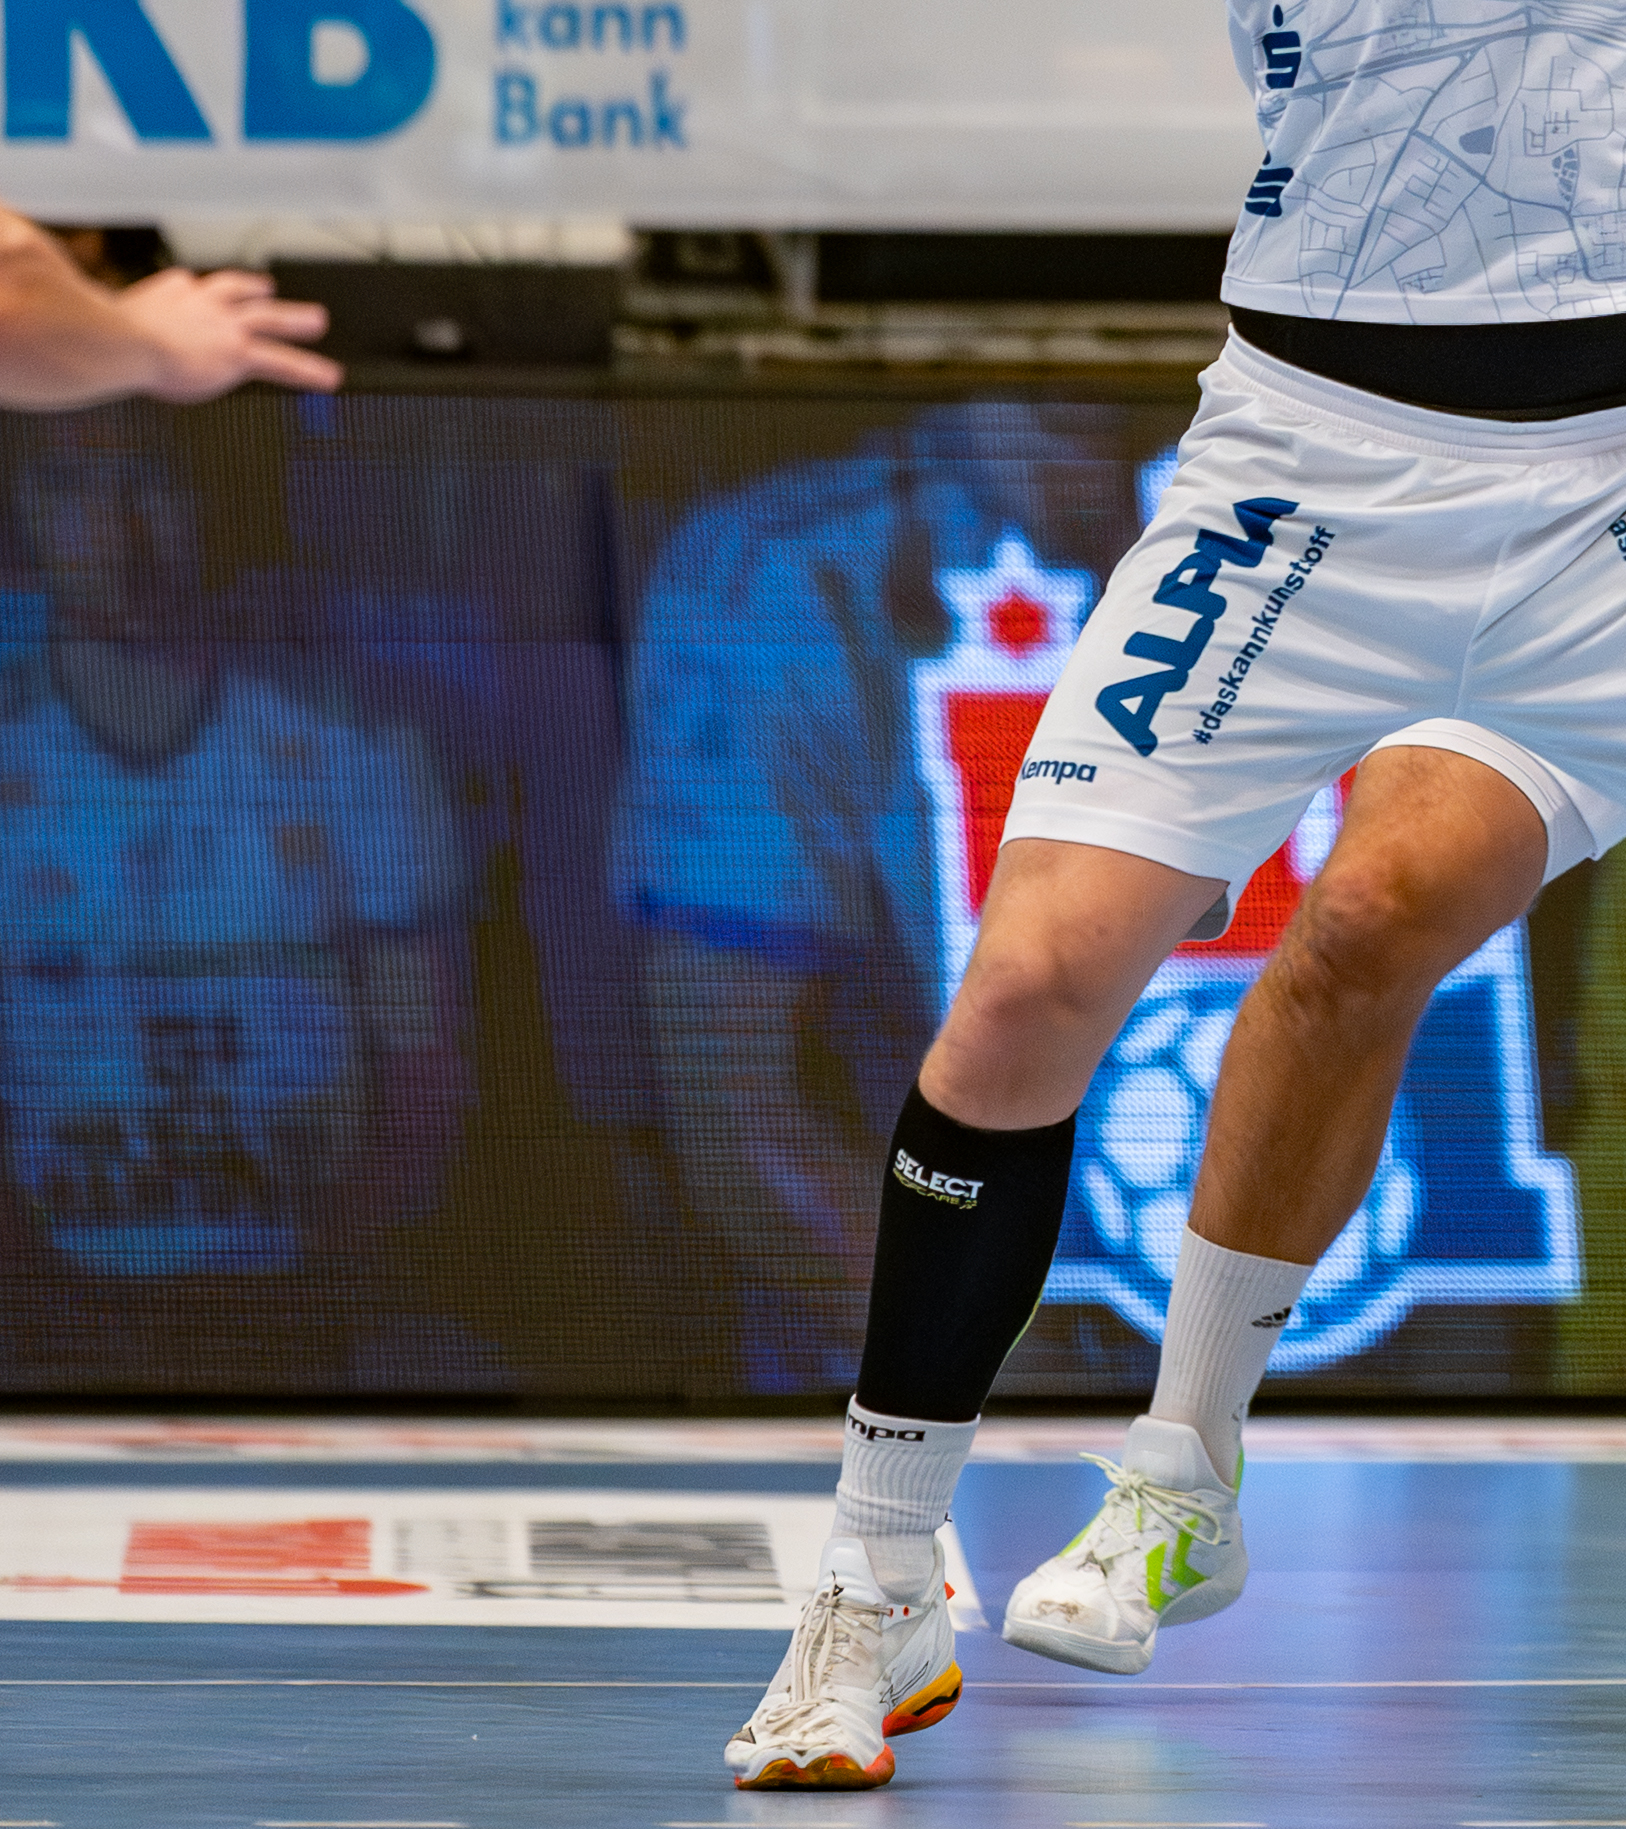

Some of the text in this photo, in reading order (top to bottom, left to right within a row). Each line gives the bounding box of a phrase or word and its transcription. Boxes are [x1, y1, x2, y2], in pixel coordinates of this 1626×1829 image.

[497, 71, 689, 149] Bank
[894, 1148, 984, 1200] SELECT
[848, 1413, 926, 1442] mpa
